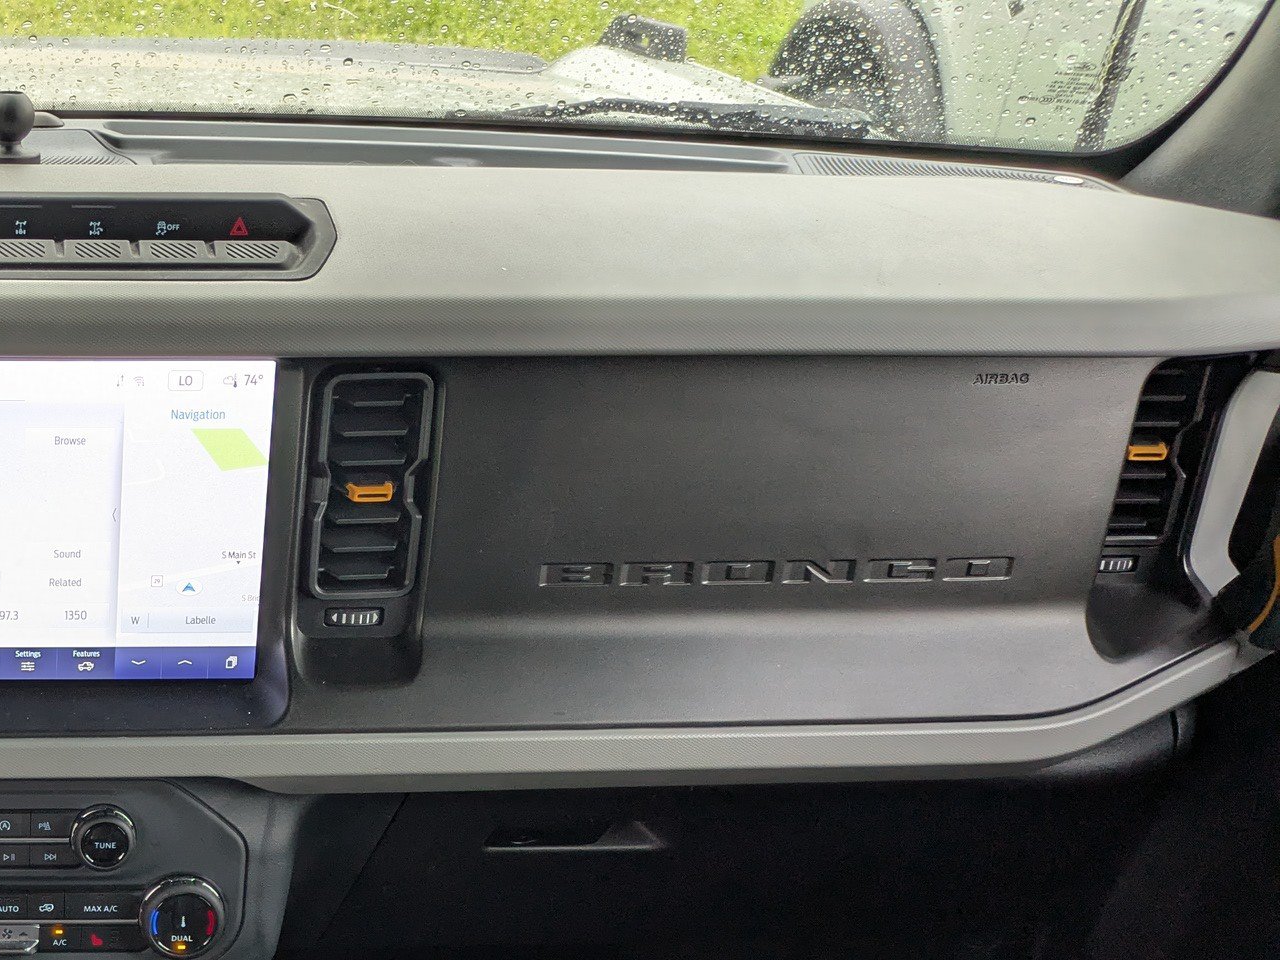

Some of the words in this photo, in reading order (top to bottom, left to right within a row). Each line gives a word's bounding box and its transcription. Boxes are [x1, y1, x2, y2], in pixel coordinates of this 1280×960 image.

[178, 376, 193, 386] LO
[244, 375, 264, 386] 74°
[973, 373, 1030, 385] AIRBAG
[170, 409, 226, 422] Navigation
[54, 436, 86, 446] Browse
[53, 549, 81, 559] Sound
[228, 551, 247, 559] Main
[248, 551, 257, 559] St
[538, 556, 1015, 587] BRONCO
[49, 577, 82, 587] Related
[64, 610, 87, 621] 1350
[130, 616, 140, 625] W
[185, 616, 216, 625] Labelle
[15, 650, 41, 660] Settings
[72, 650, 100, 658] Features
[94, 841, 117, 849] TUNE
[83, 905, 102, 913] MAX
[103, 905, 118, 913] A/C
[52, 939, 67, 947] A/C
[171, 935, 193, 943] DUAL
